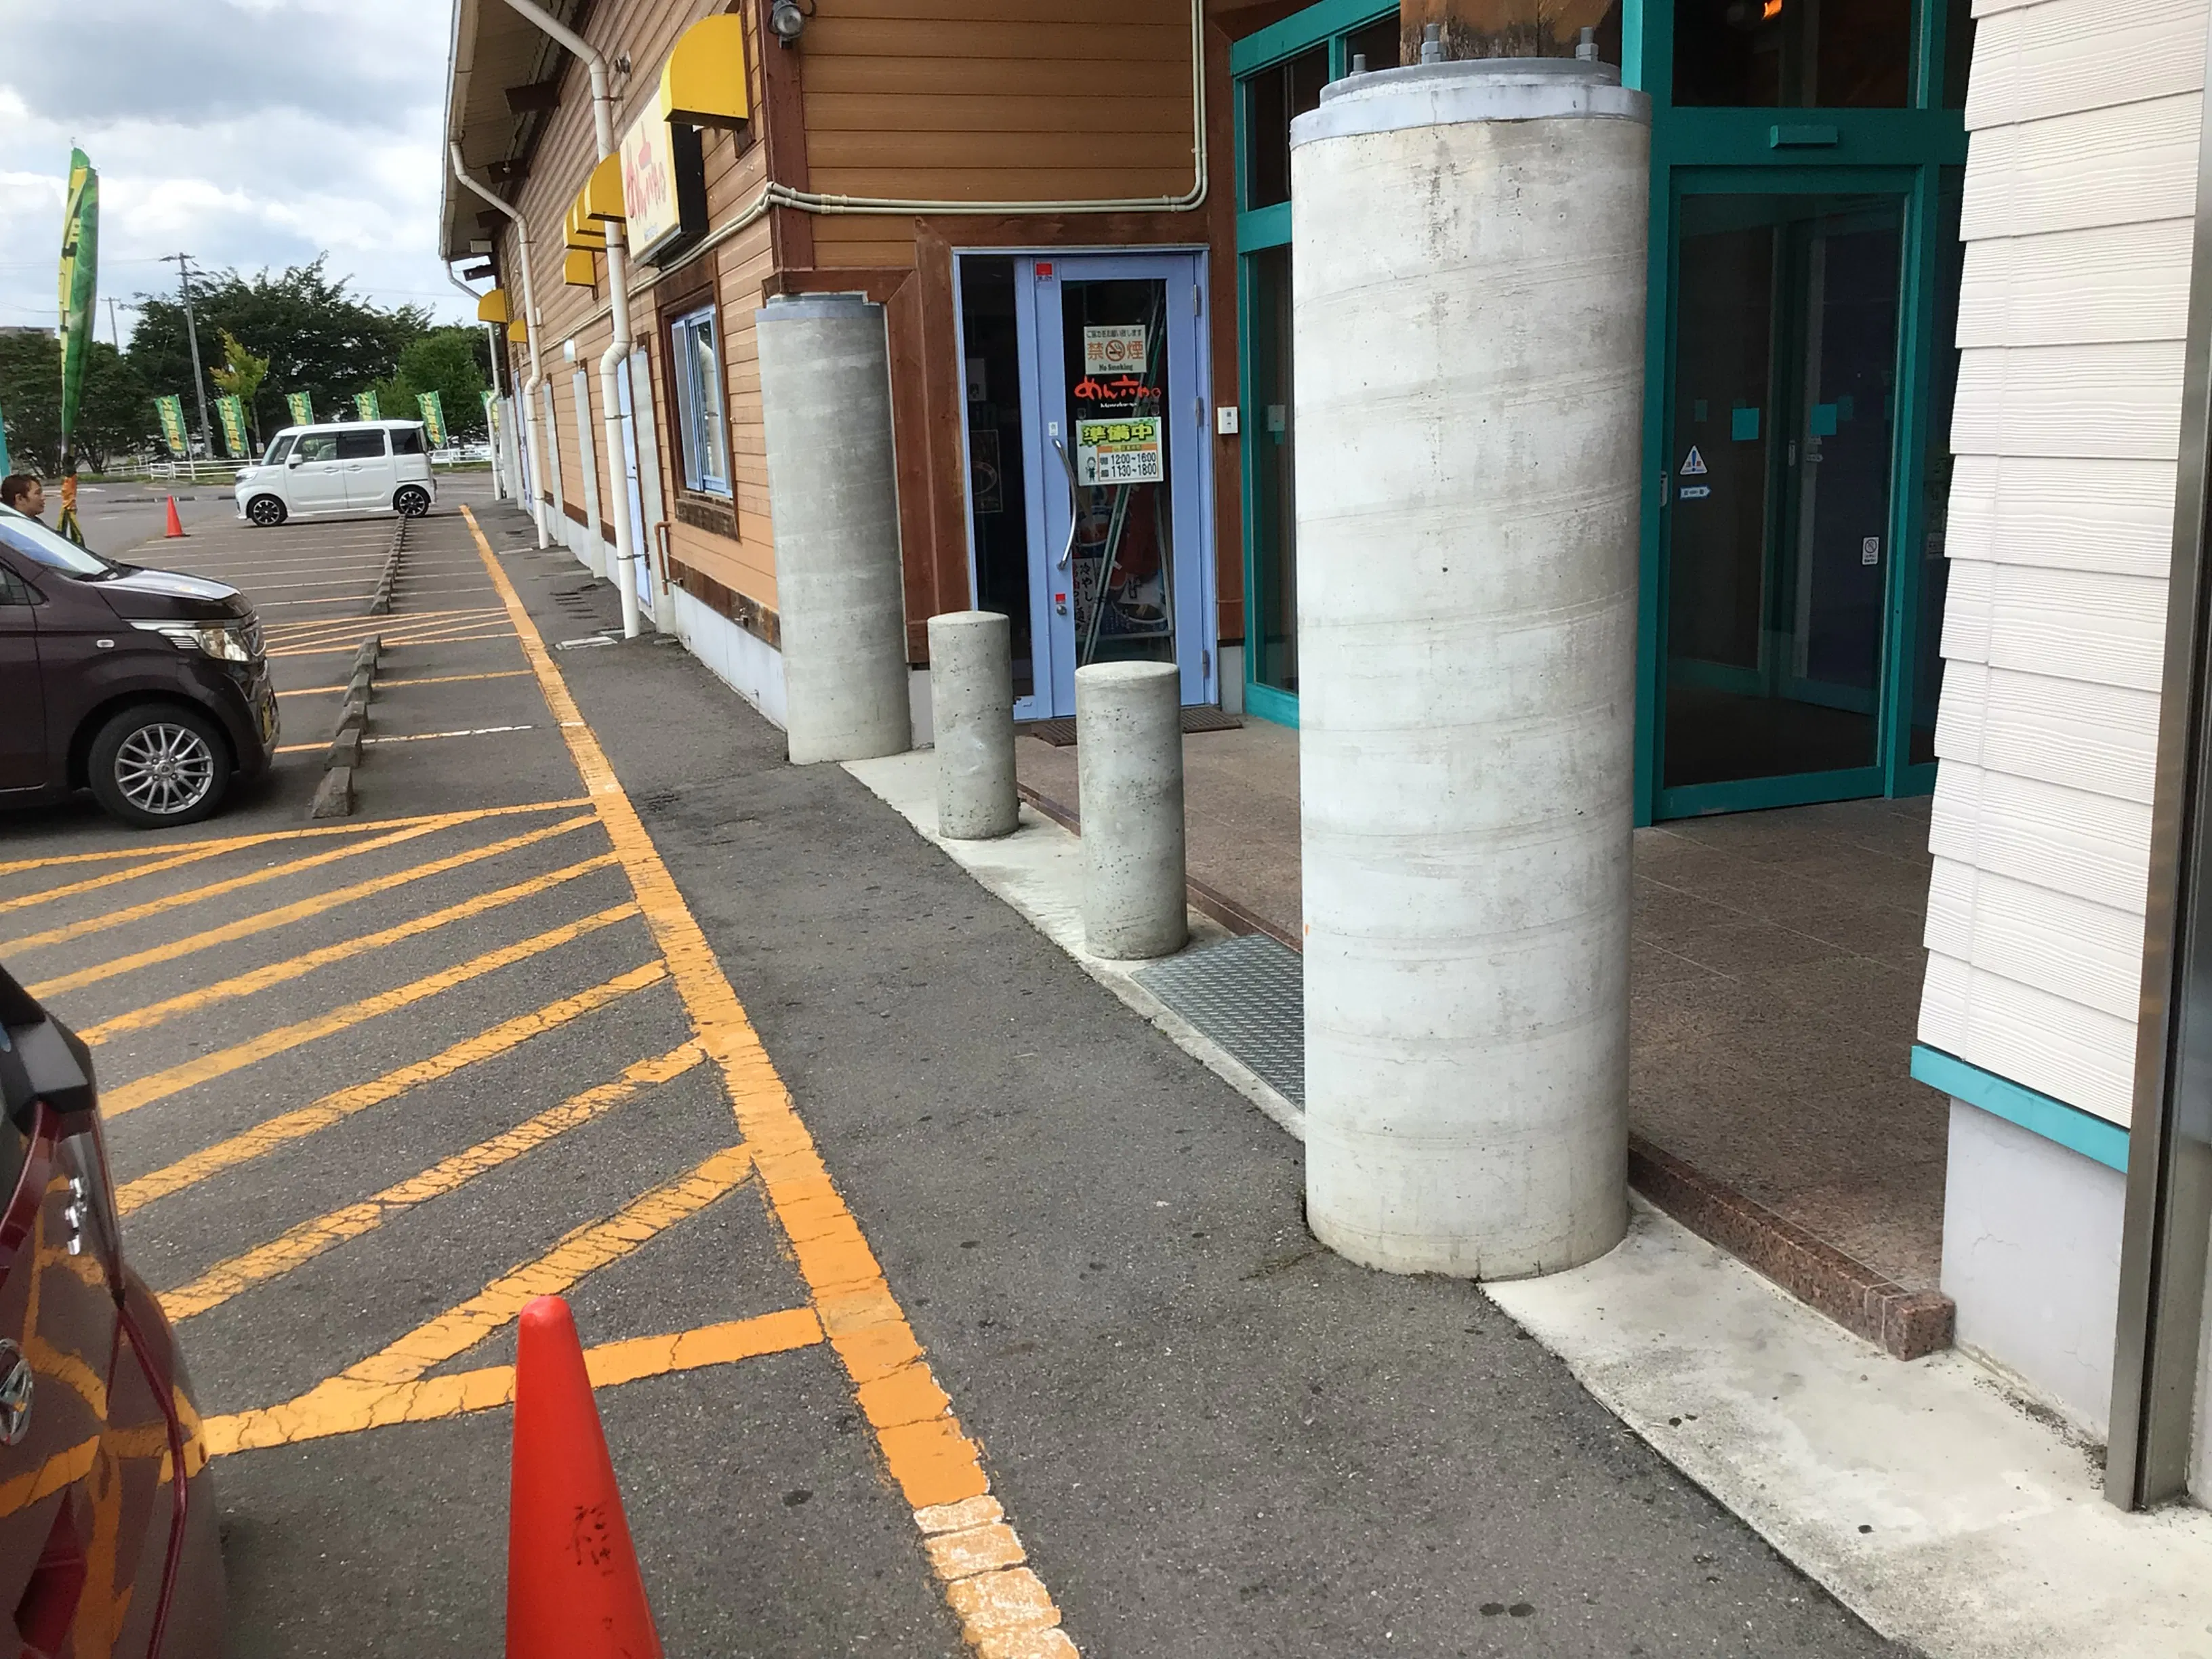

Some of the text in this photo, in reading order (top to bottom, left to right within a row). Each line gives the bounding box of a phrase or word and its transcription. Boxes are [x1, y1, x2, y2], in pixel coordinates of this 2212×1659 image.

[1087, 340, 1144, 361] 禁 煙
[1083, 423, 1153, 443] 準備中
